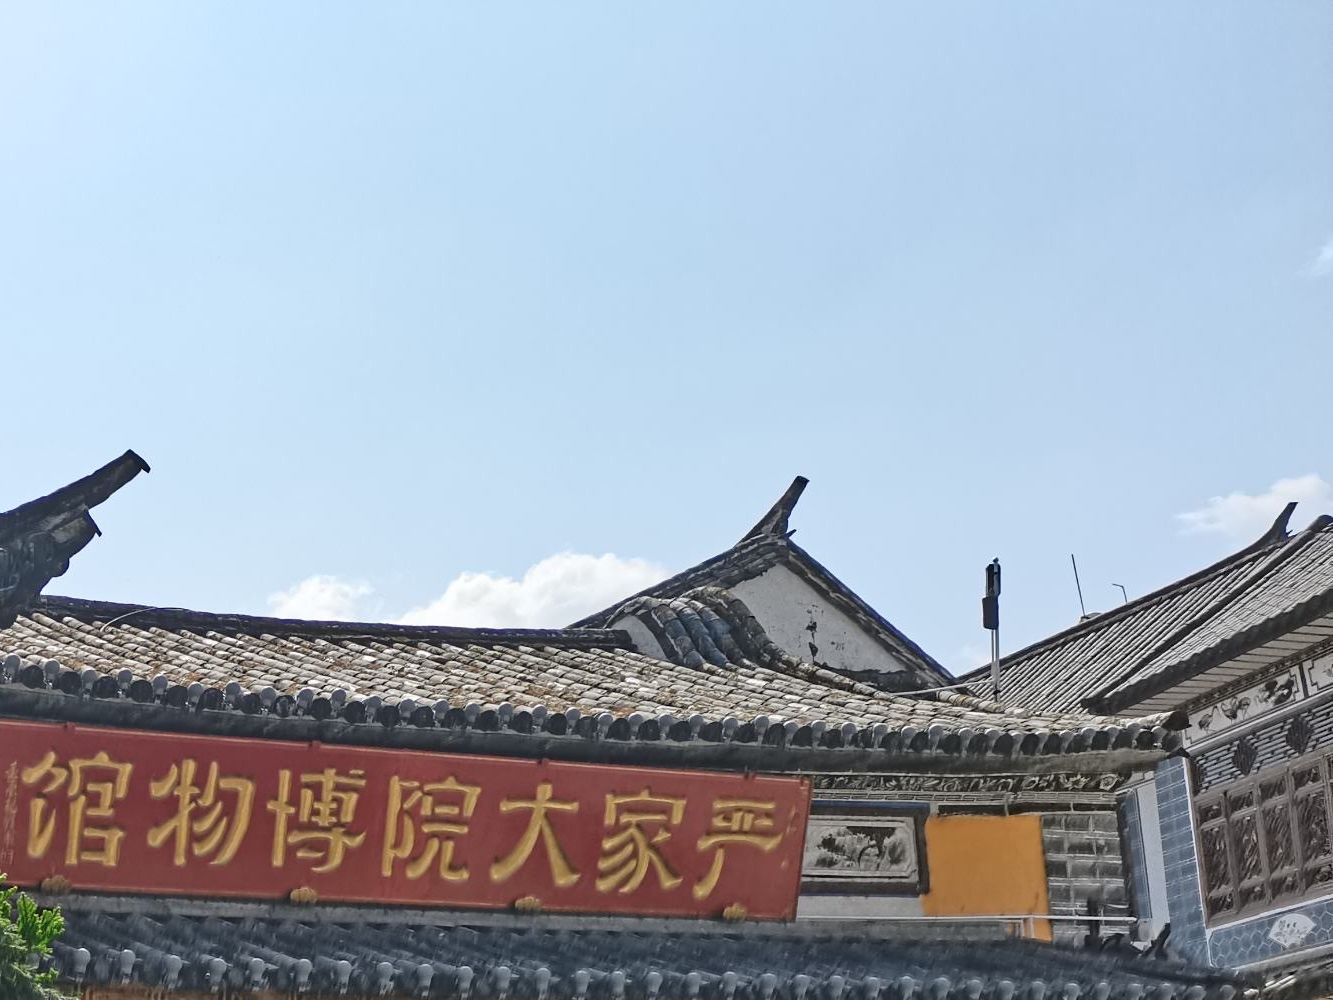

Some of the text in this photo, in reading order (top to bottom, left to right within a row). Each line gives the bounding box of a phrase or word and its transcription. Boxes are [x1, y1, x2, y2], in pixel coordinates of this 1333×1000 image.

[21, 750, 784, 900] 严家大院博物馆
